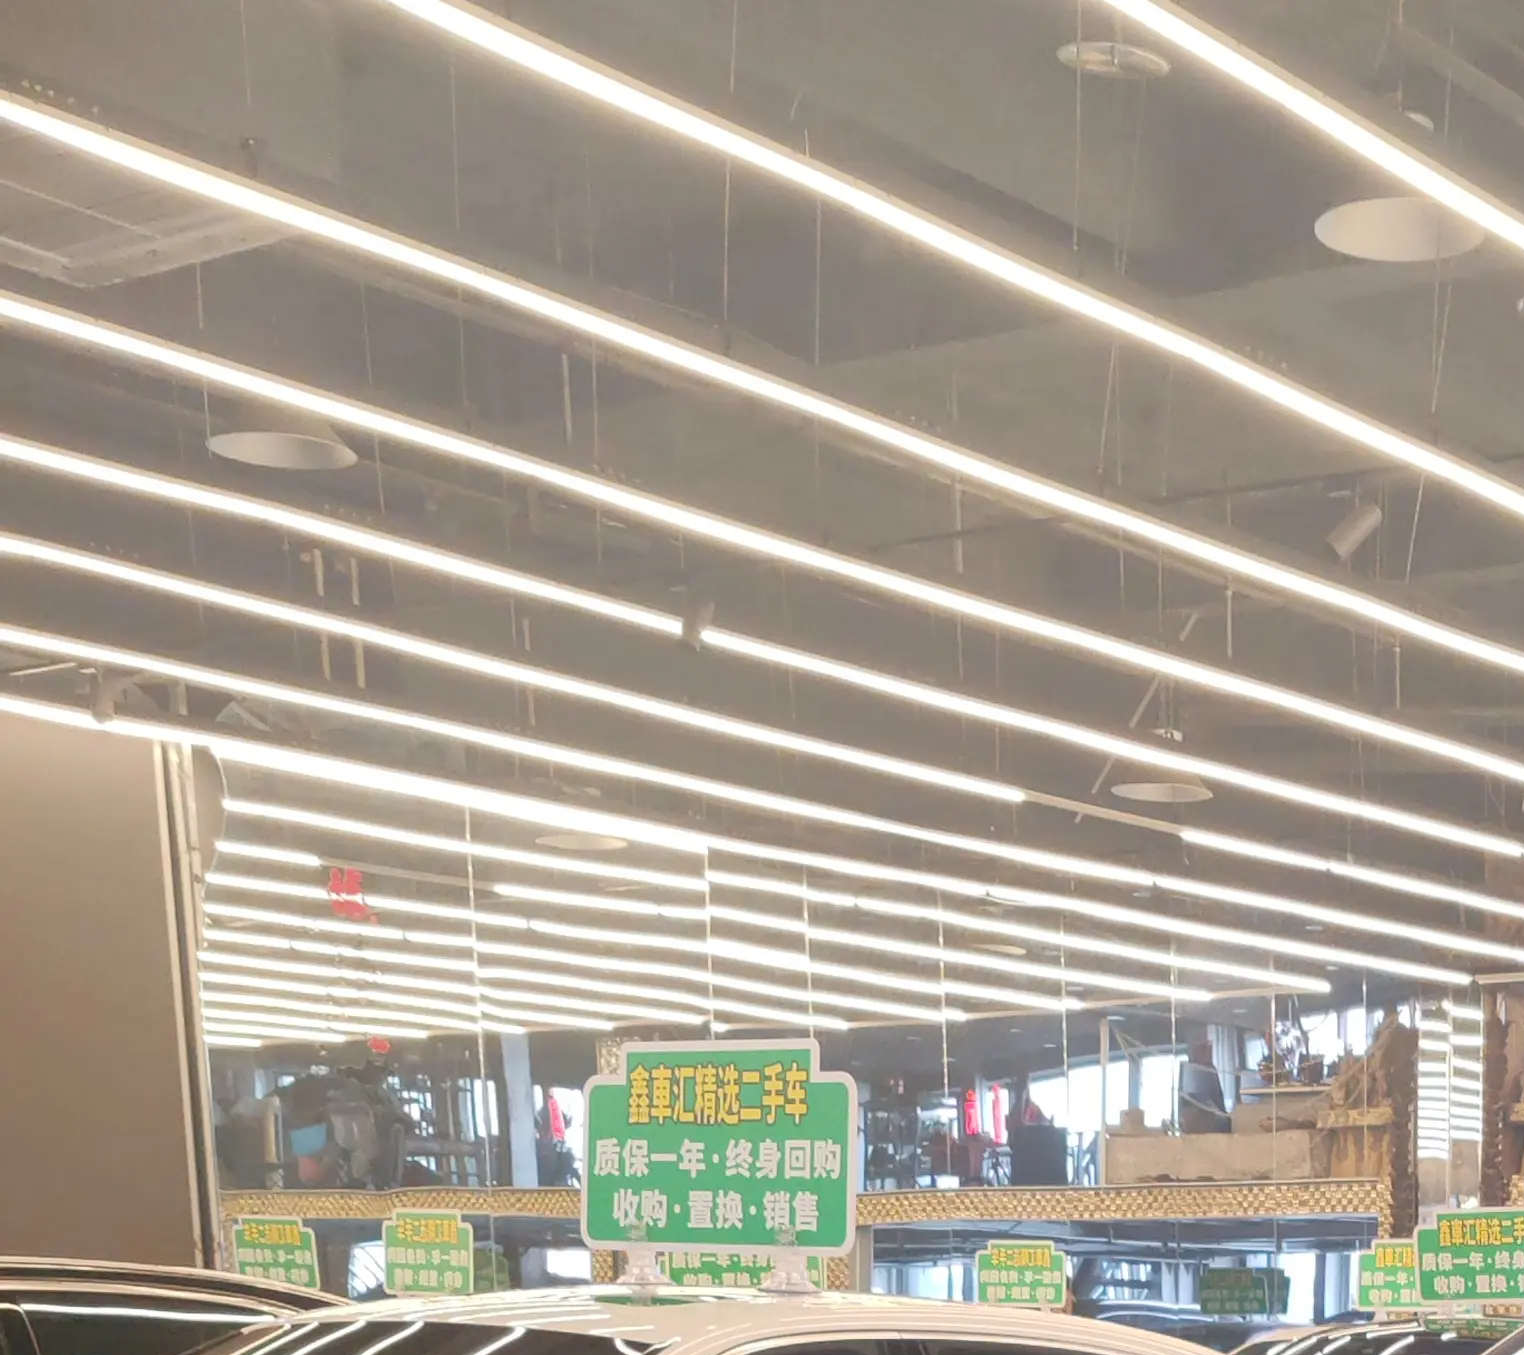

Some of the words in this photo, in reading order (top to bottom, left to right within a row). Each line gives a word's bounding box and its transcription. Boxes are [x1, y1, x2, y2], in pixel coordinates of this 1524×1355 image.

[628, 1061, 809, 1126] 鑫車汇精选二手车
[593, 1138, 841, 1179] 质保一年·终身回购
